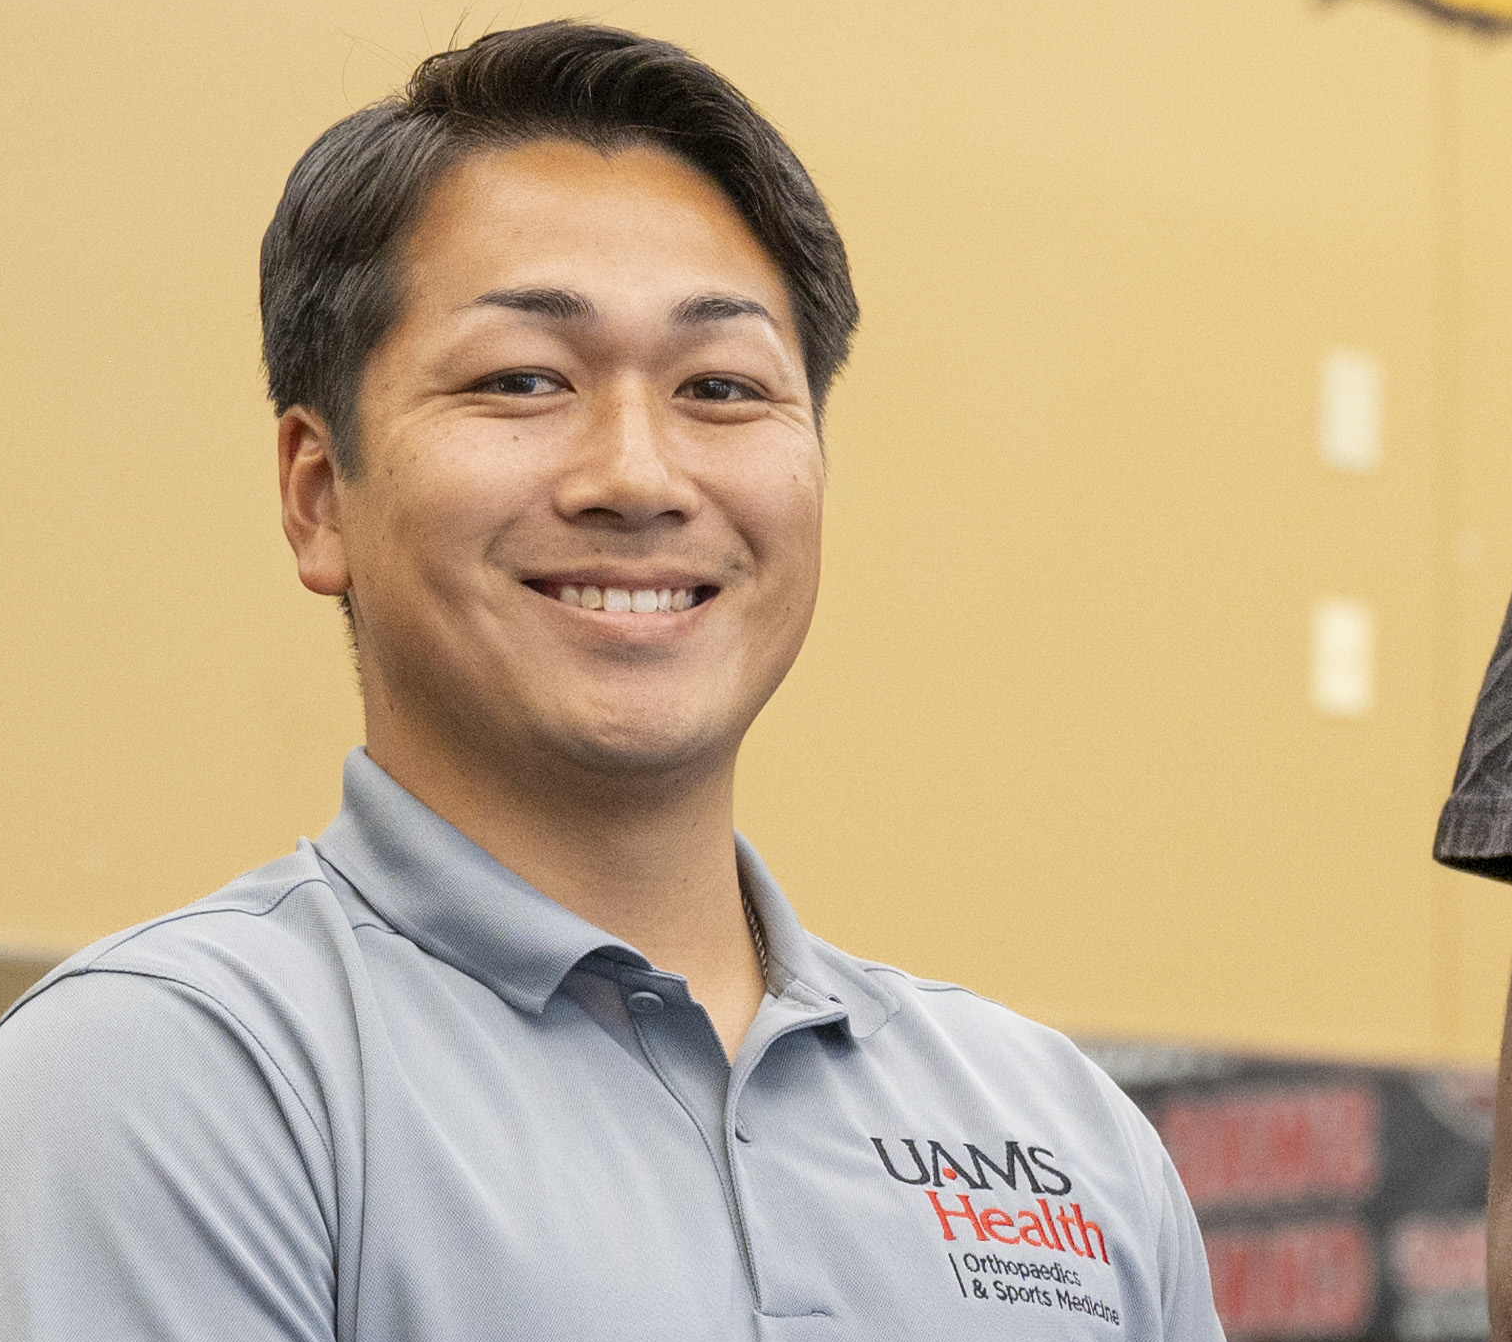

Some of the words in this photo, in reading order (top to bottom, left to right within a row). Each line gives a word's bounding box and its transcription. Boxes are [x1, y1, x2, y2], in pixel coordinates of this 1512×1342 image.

[870, 1137, 1072, 1196] UAMS
[924, 1190, 1111, 1265] Health
[963, 1252, 1081, 1287] Orthopaedics
[973, 1278, 989, 1300] &
[992, 1280, 1052, 1308] Sports
[1055, 1288, 1120, 1327] Medicine
